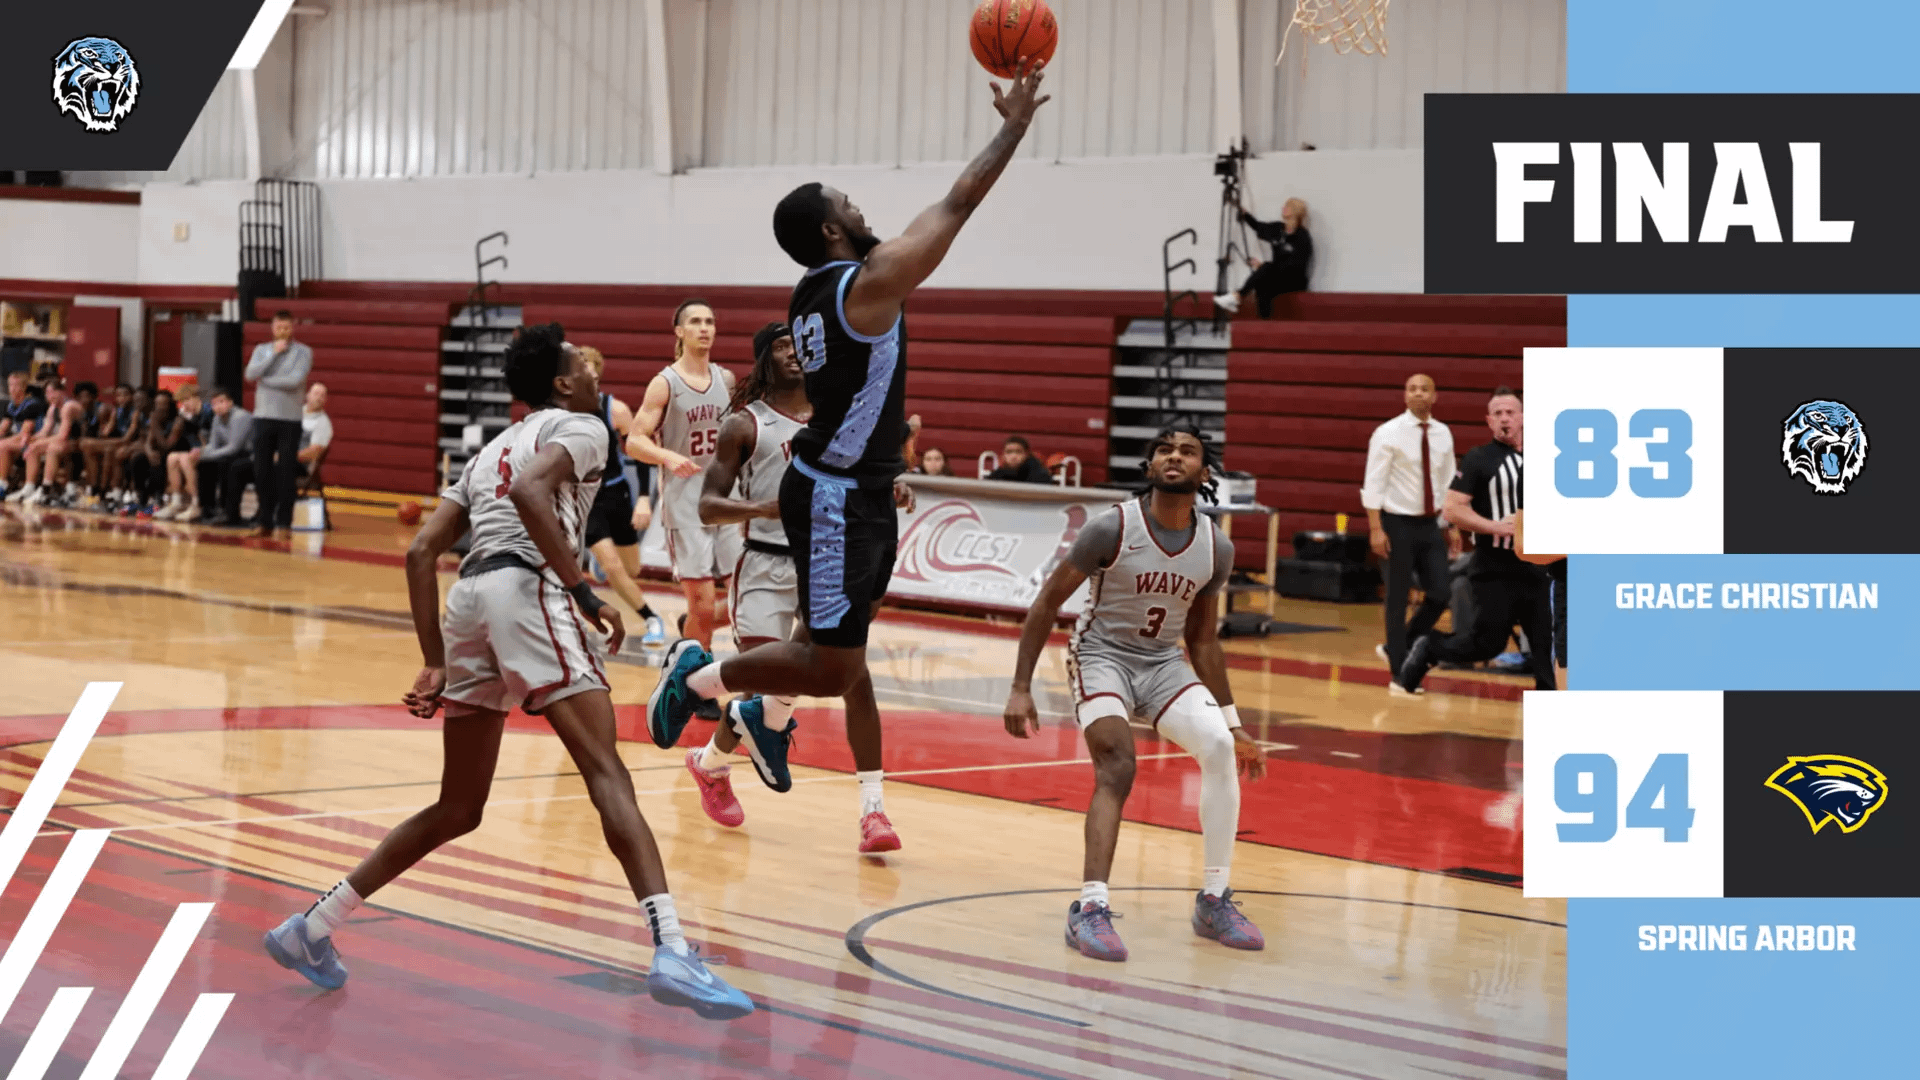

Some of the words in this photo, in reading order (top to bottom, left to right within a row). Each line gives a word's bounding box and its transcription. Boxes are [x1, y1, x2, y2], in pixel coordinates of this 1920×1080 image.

[792, 312, 827, 373] 13
[689, 428, 719, 457] 25
[1135, 571, 1196, 602] WAVE
[1139, 606, 1167, 639] 3
